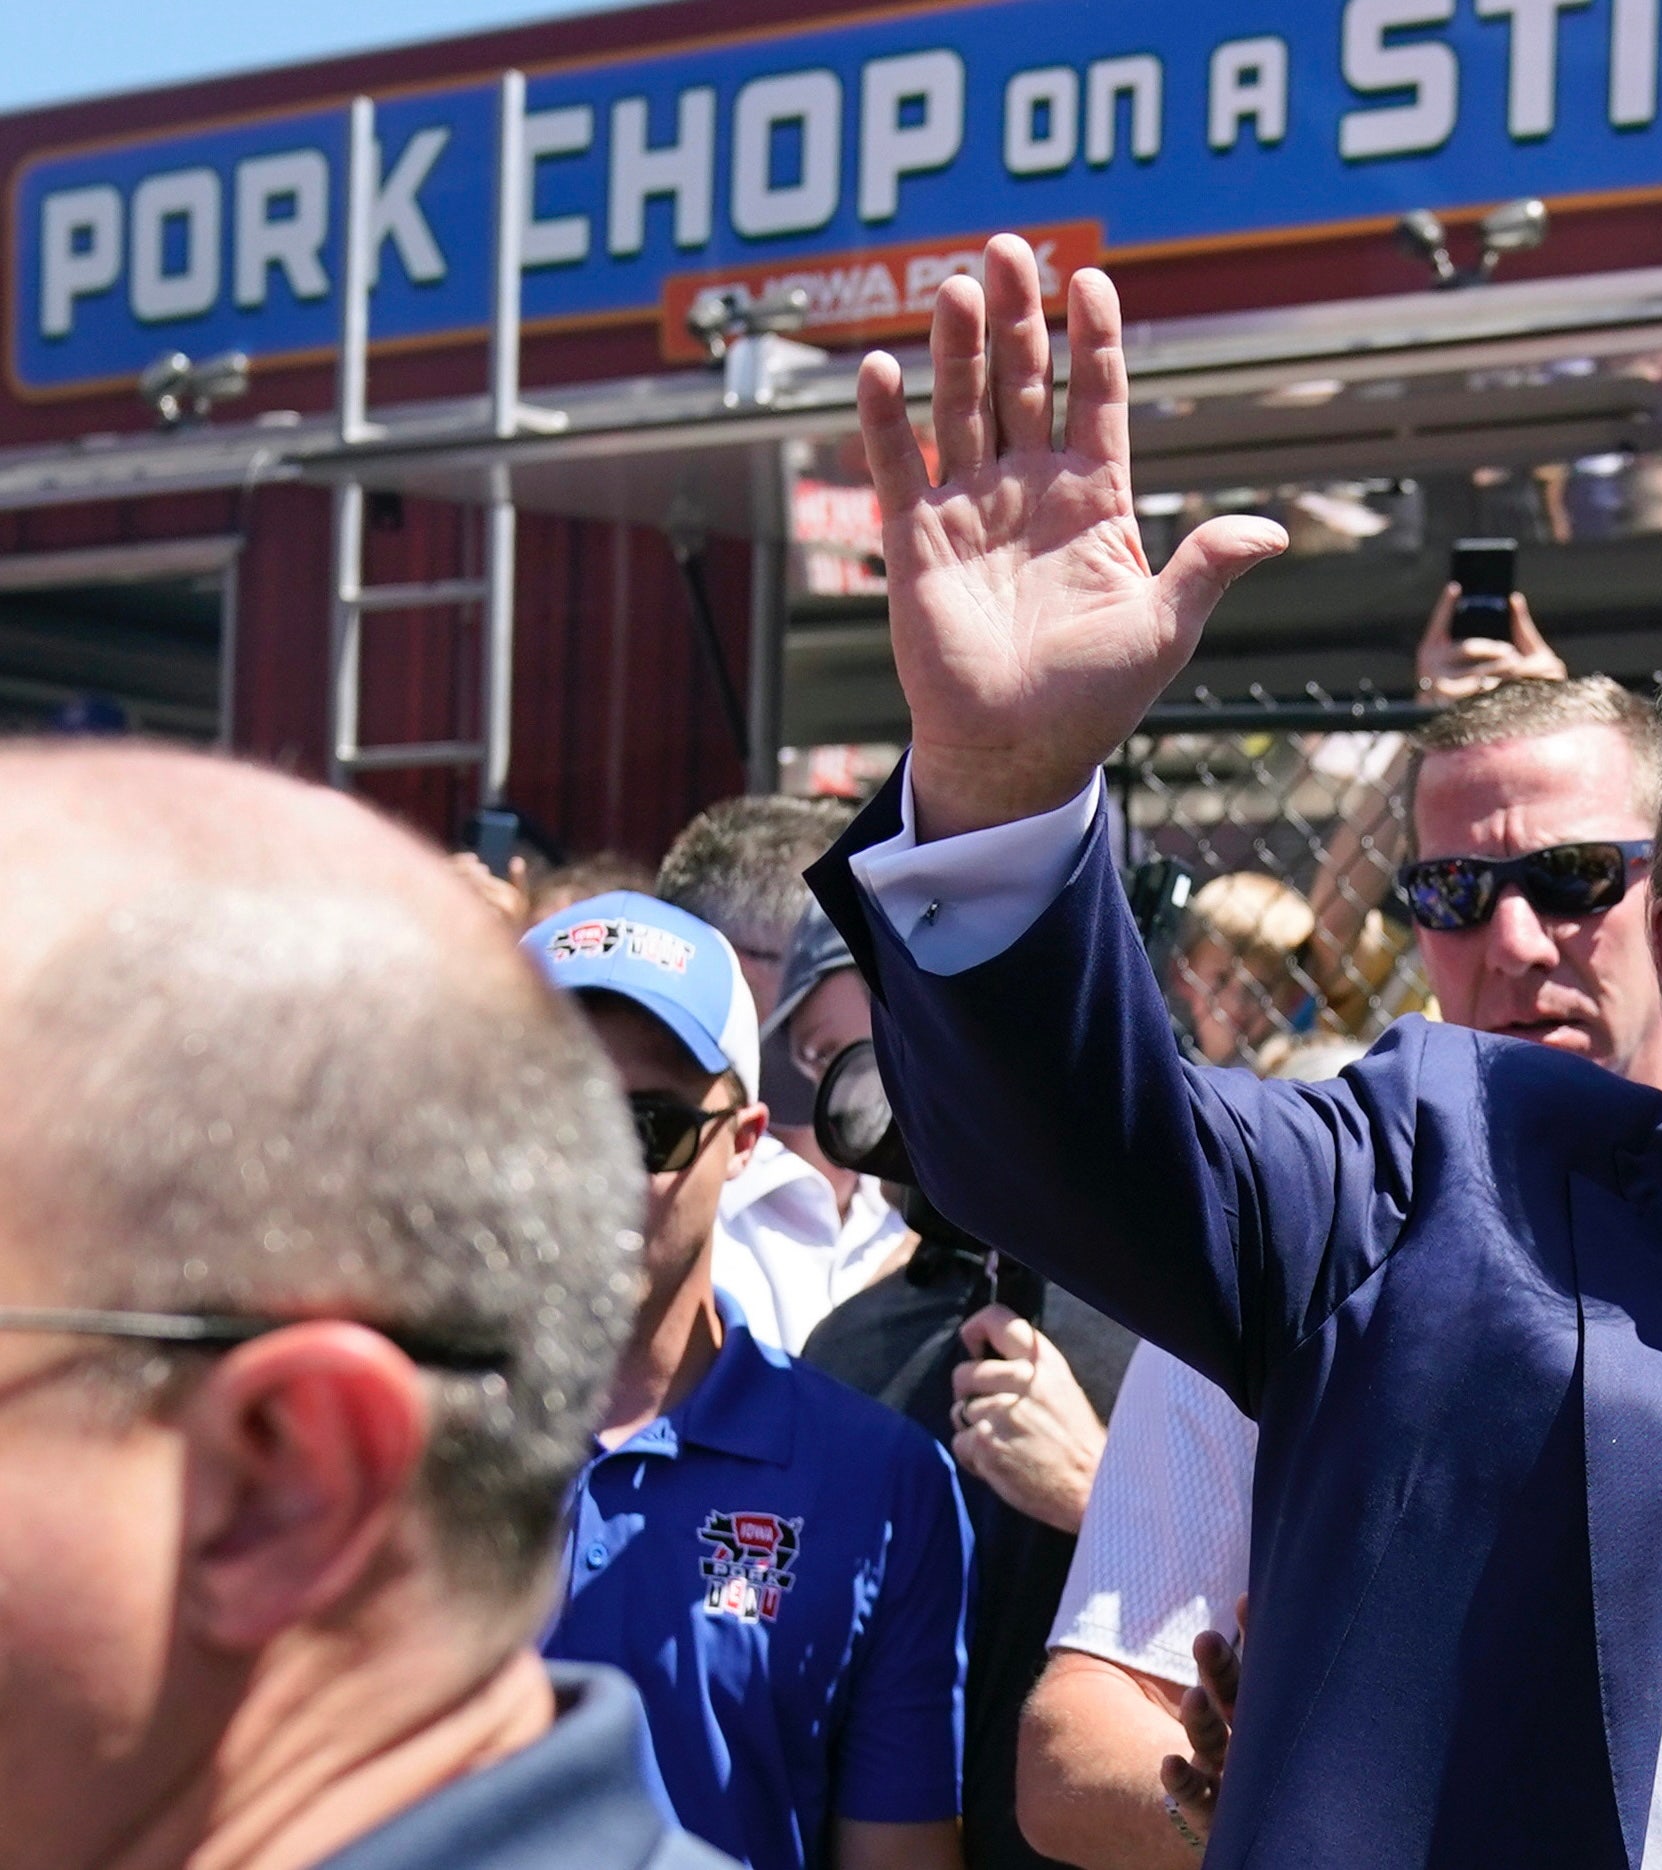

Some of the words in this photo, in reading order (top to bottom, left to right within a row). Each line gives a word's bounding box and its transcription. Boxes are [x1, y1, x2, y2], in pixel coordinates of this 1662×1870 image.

[40, 125, 451, 338] PORK
[522, 48, 966, 269] CHOP
[1208, 35, 1288, 151] A
